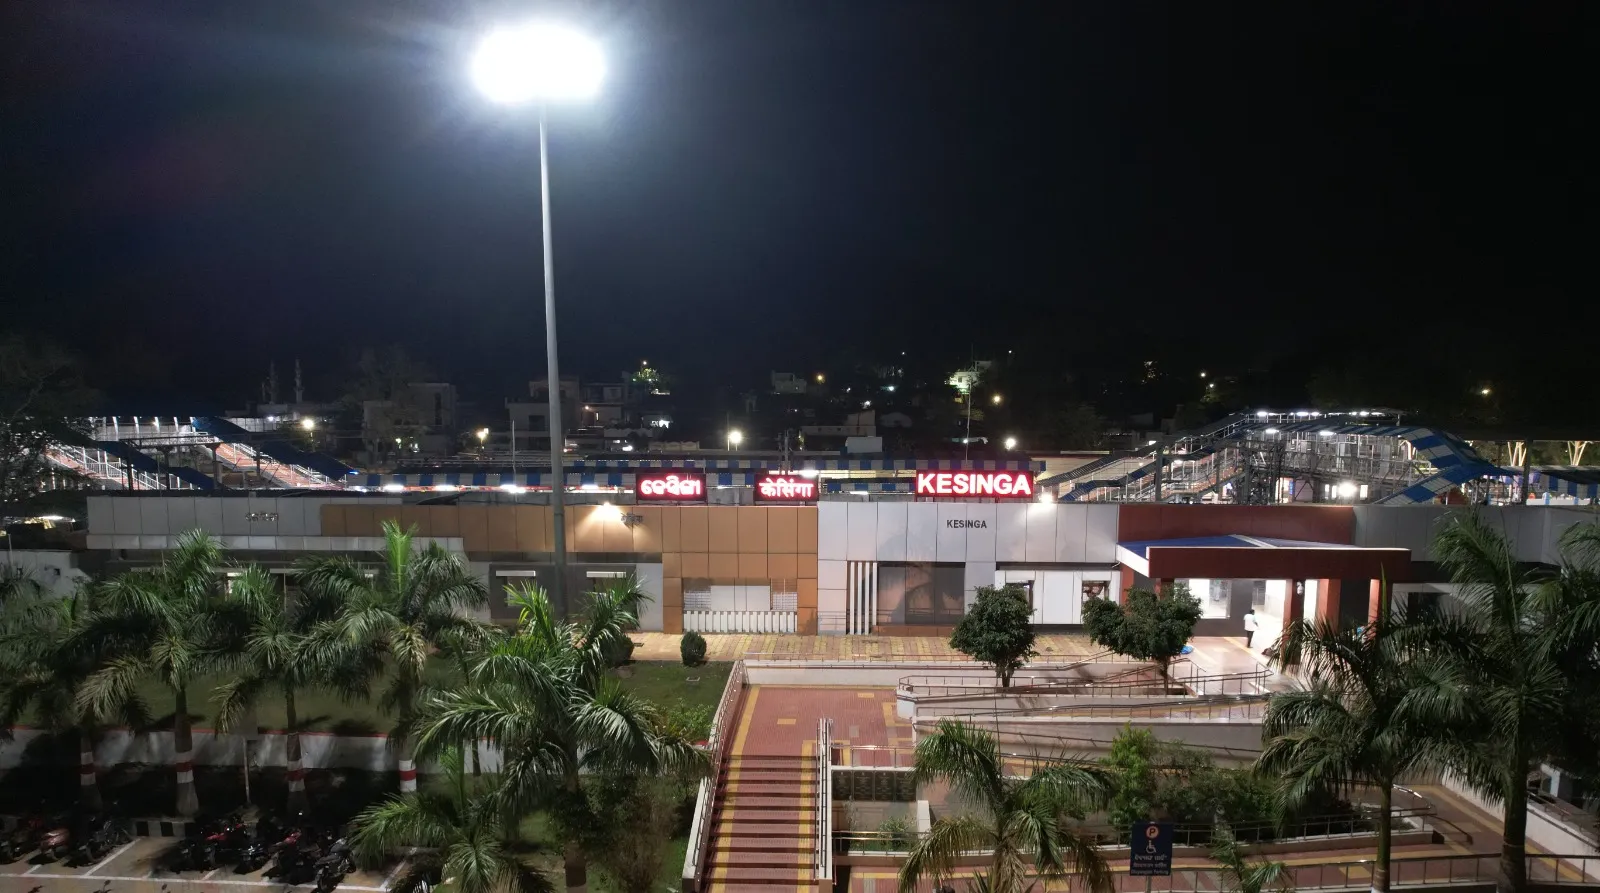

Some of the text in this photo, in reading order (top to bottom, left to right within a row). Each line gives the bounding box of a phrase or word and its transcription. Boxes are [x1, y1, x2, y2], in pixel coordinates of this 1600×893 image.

[758, 477, 814, 498] केसिंगा
[917, 473, 1032, 495] KESINGA
[946, 519, 987, 529] KESINGA
